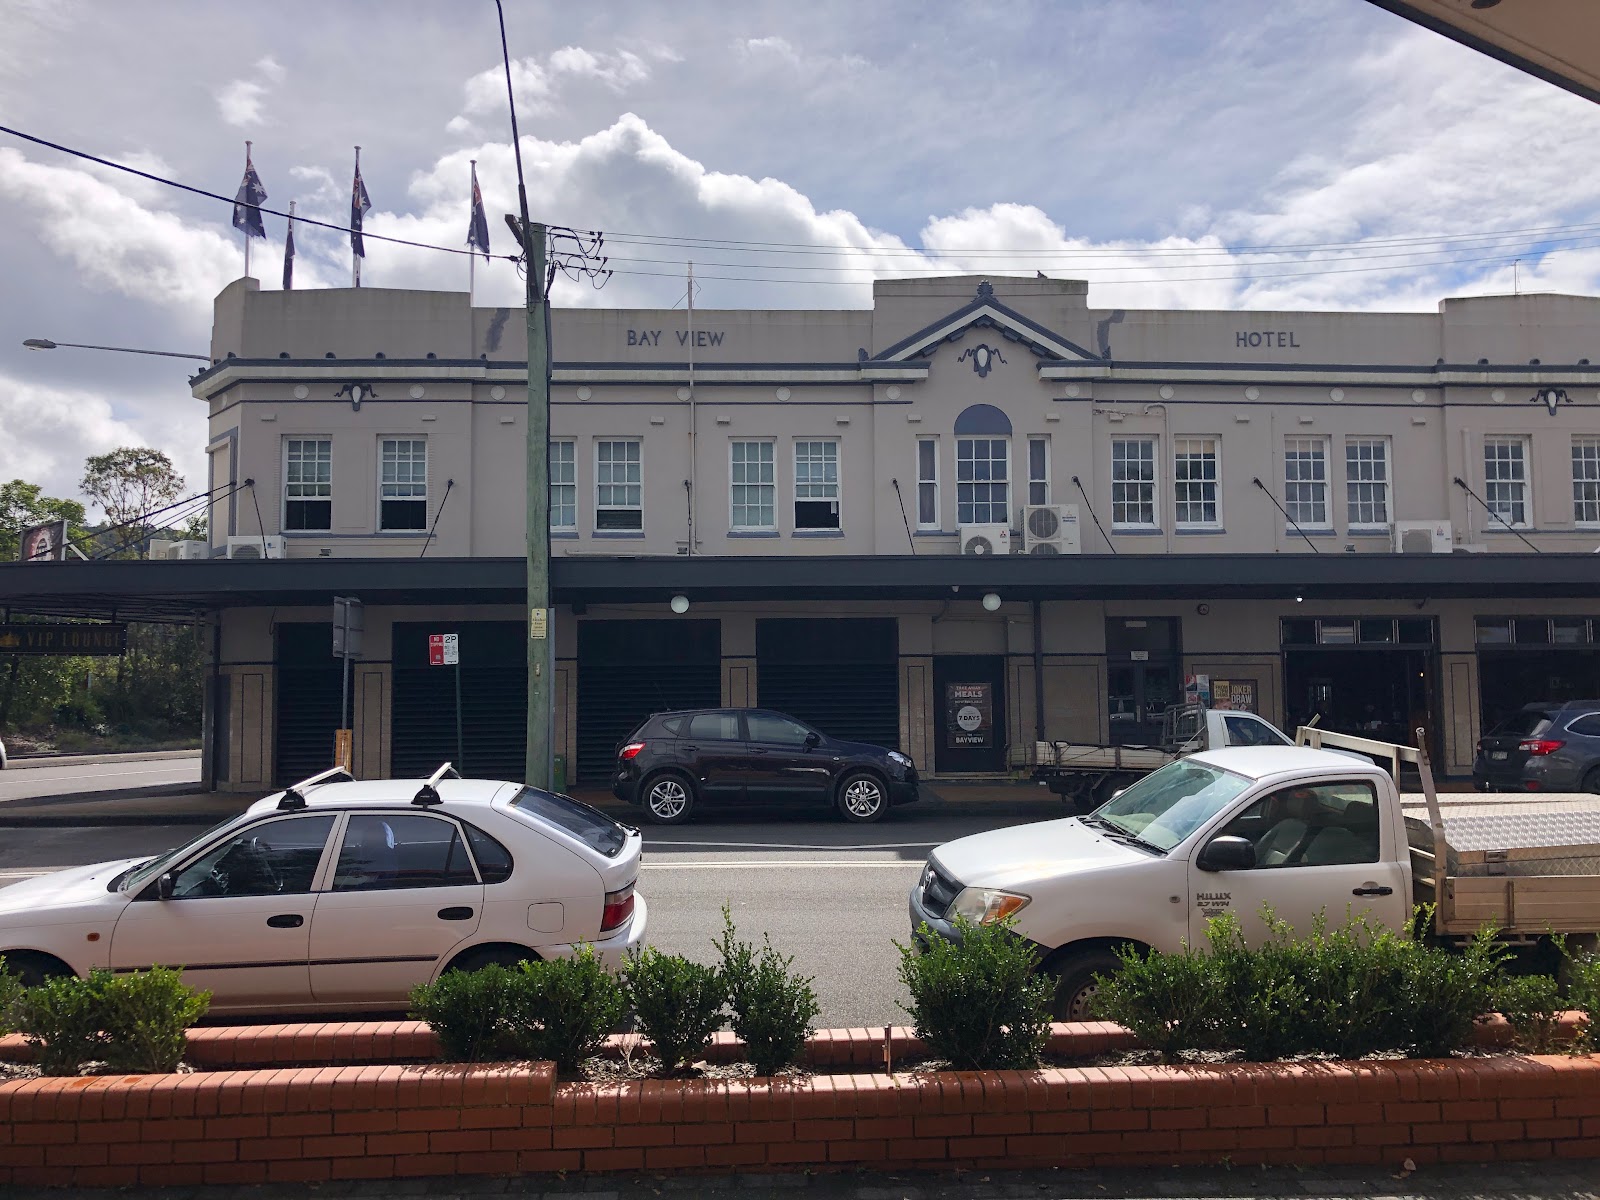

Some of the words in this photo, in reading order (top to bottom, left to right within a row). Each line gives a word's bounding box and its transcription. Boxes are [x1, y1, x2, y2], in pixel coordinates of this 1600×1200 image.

[627, 329, 661, 346] BAY
[675, 330, 724, 346] VIEW
[1235, 331, 1300, 348] HOTEL
[27, 631, 53, 647] VIP
[62, 631, 121, 648] LOUNGE
[445, 635, 457, 643] 2P
[1231, 685, 1252, 694] JOKER
[1231, 694, 1252, 704] DRAW
[1196, 892, 1231, 900] HILUX
